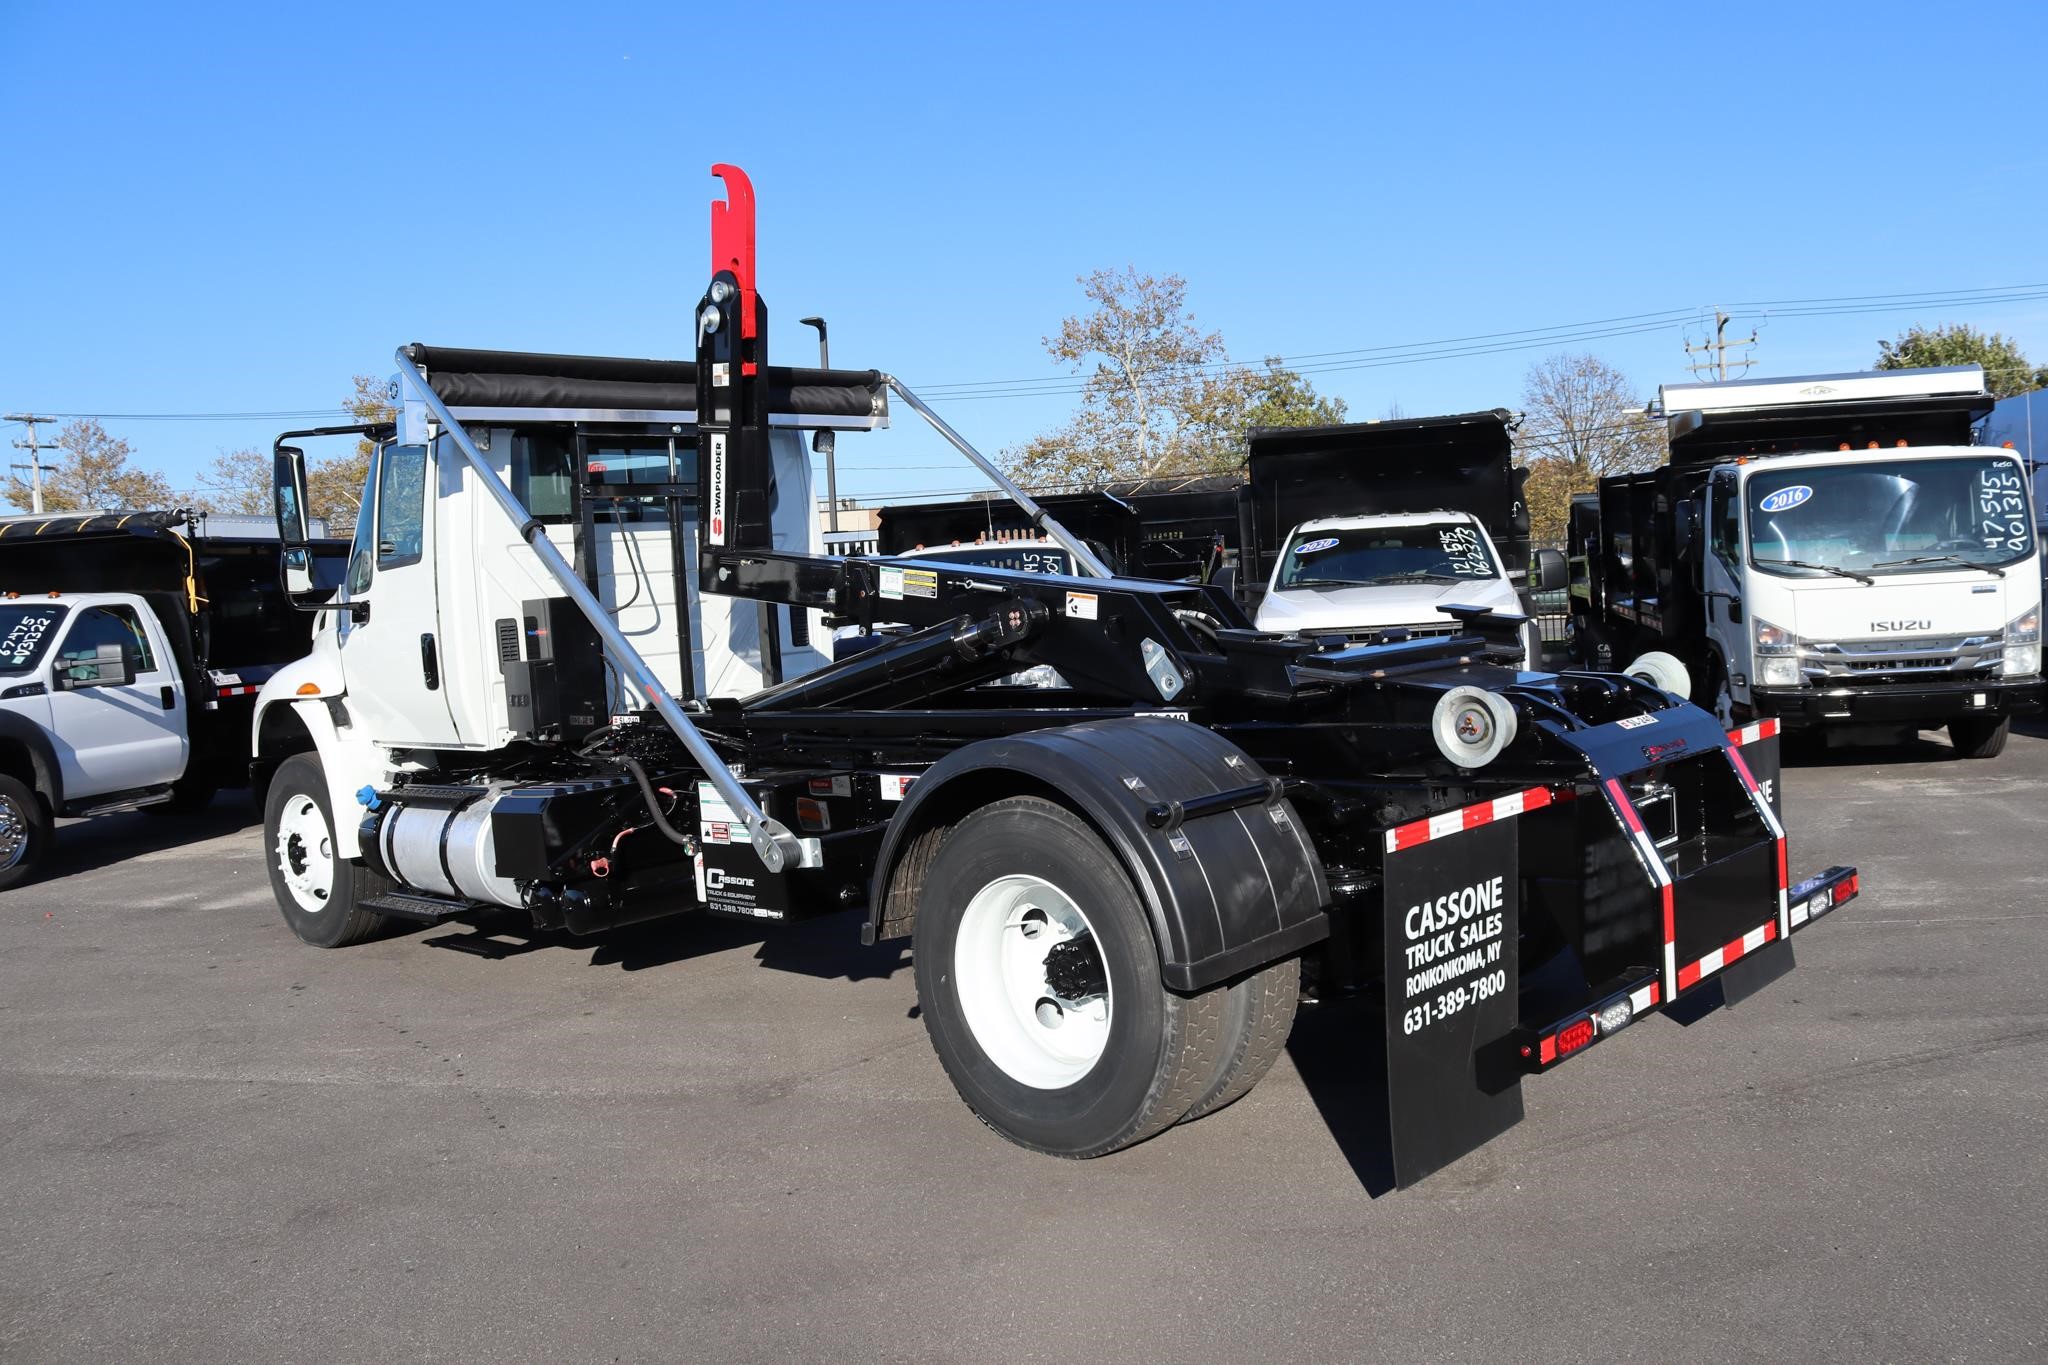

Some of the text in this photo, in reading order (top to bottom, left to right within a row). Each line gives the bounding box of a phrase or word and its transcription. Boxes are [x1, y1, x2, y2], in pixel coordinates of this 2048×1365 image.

[1770, 489, 1803, 510] 2016
[1980, 470, 2005, 549] 47.545
[1870, 620, 1931, 632] ISUZU
[706, 889, 723, 897] TRUCK
[1404, 875, 1503, 940] CASSONE
[1405, 912, 1502, 970] TRUCK SALES
[1406, 940, 1502, 999] RONKONKOMA, NY
[1403, 969, 1506, 1035] 631-389-7800
